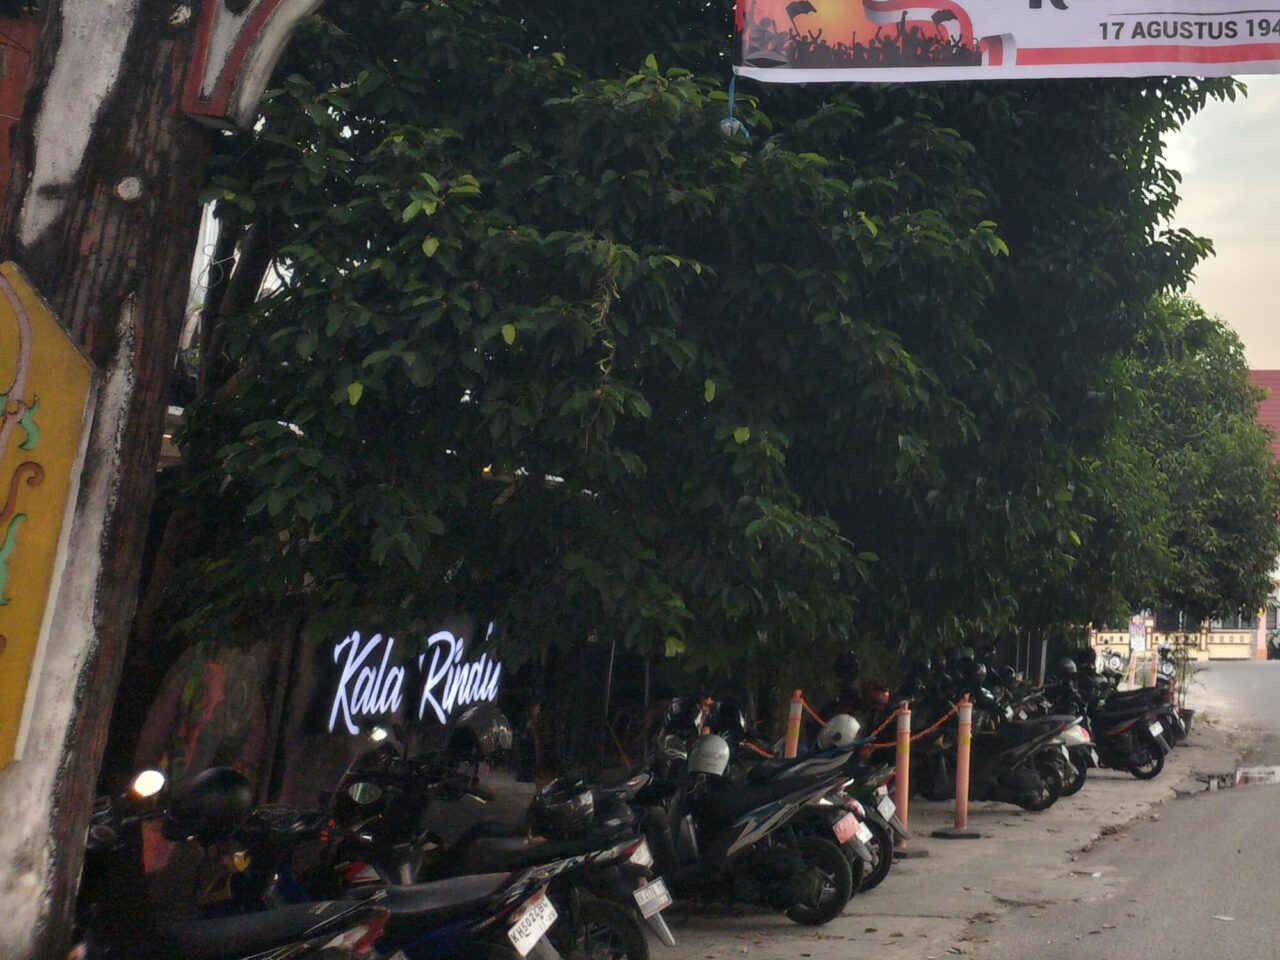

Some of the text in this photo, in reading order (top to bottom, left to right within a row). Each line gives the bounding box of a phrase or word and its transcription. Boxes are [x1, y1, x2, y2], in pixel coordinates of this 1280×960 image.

[1099, 21, 1126, 40] 17
[1131, 20, 1238, 40] AGUSTUS
[328, 620, 502, 736] Kala Rindu
